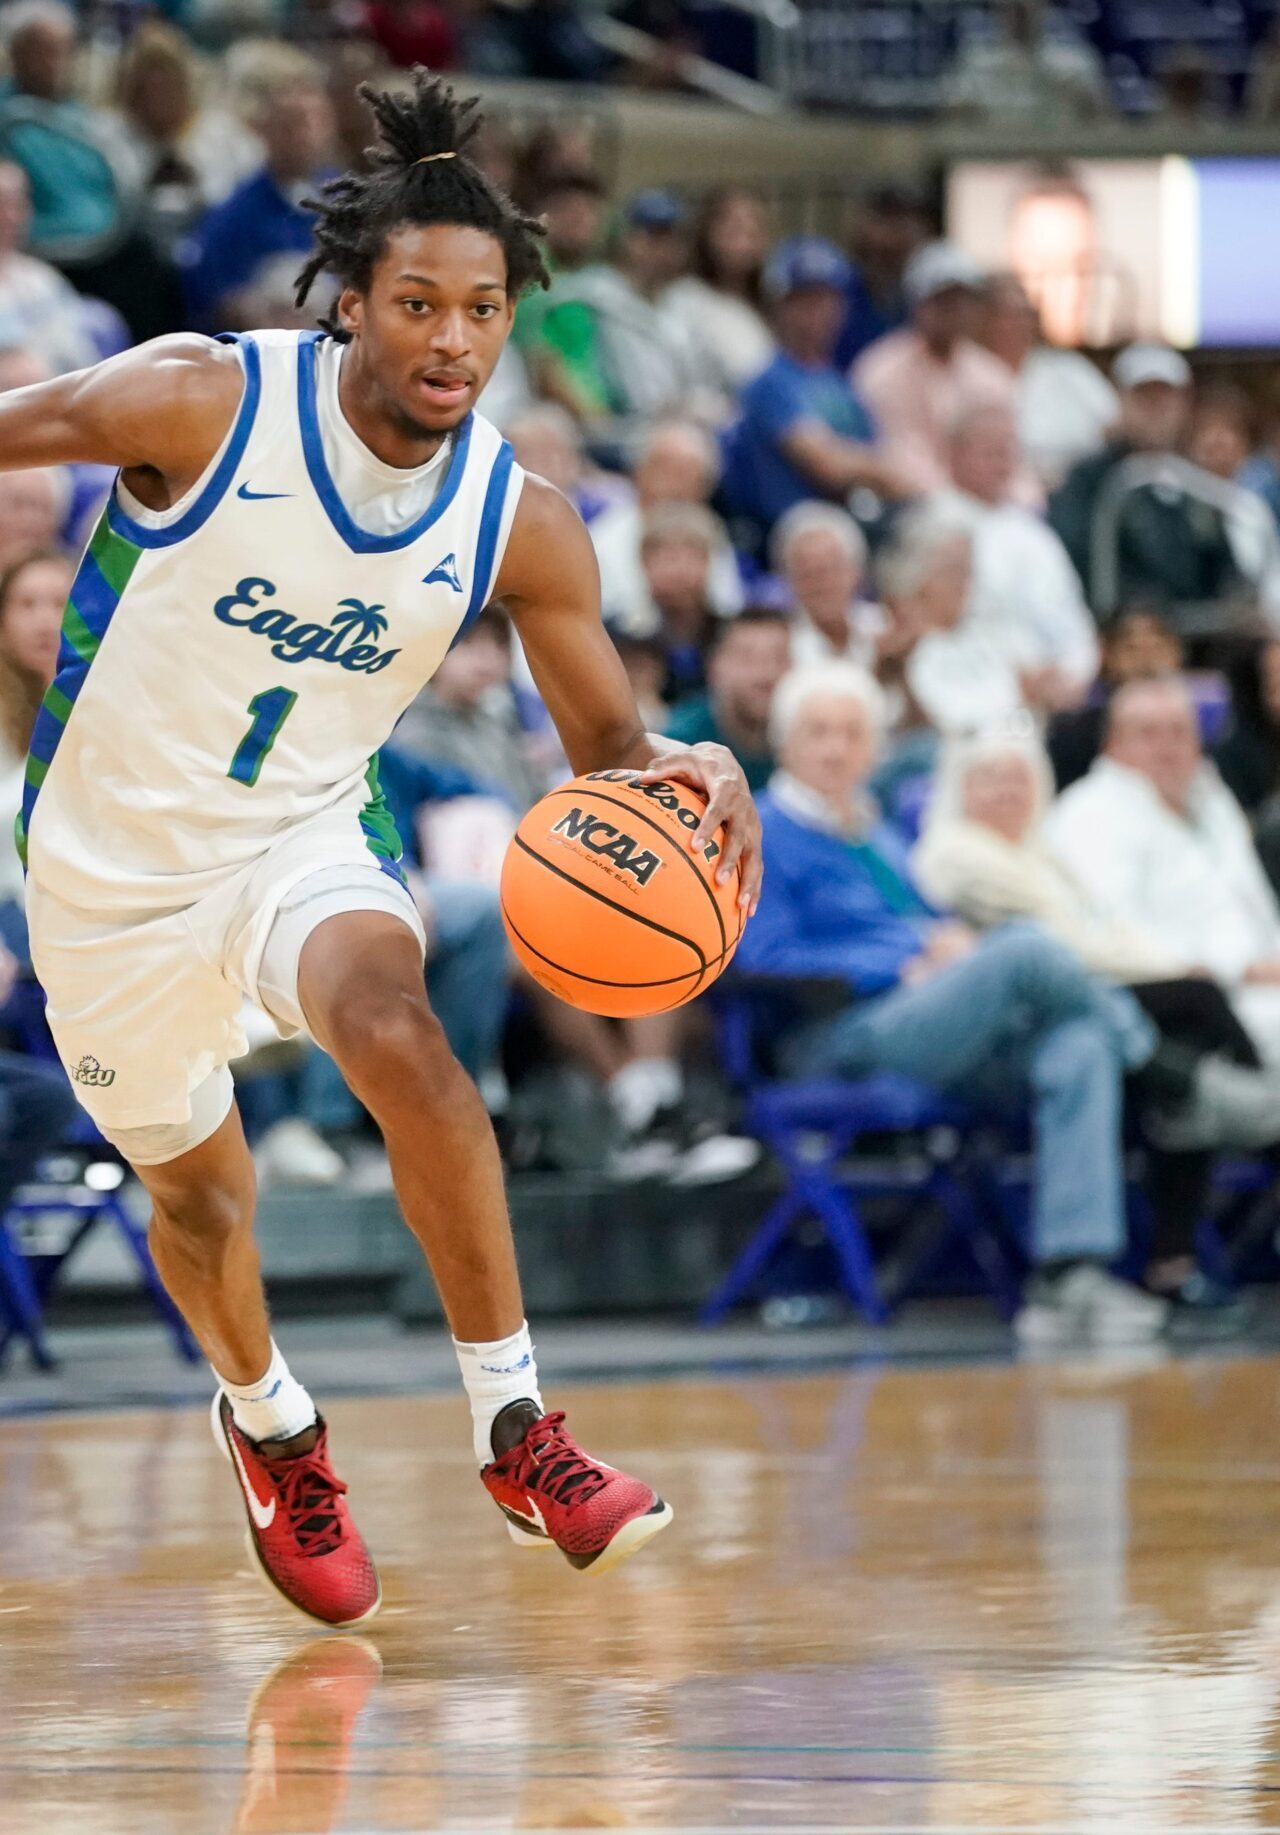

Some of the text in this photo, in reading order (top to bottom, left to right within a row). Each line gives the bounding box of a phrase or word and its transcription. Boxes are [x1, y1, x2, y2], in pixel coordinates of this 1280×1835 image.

[214, 576, 403, 675] Eagles
[226, 685, 299, 788] 1
[550, 806, 664, 889] NCAA
